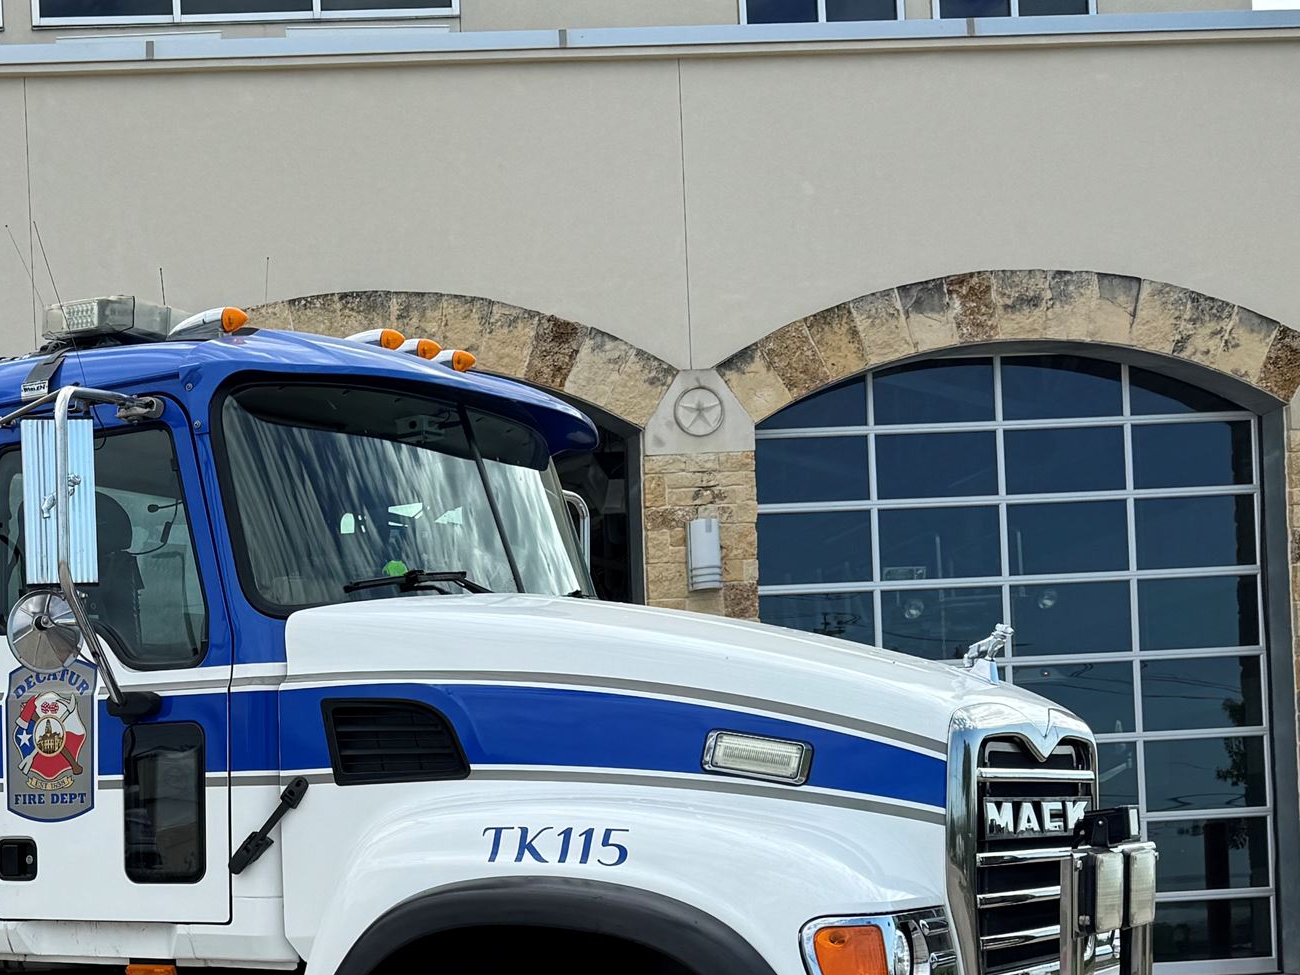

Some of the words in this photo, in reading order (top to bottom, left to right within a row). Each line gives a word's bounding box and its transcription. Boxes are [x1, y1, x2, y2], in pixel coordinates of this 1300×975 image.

[13, 668, 90, 699] DECATUR
[14, 793, 45, 805] FIRE
[51, 792, 87, 804] DEPT
[986, 801, 1088, 834] MACK
[482, 826, 630, 867] TK115
